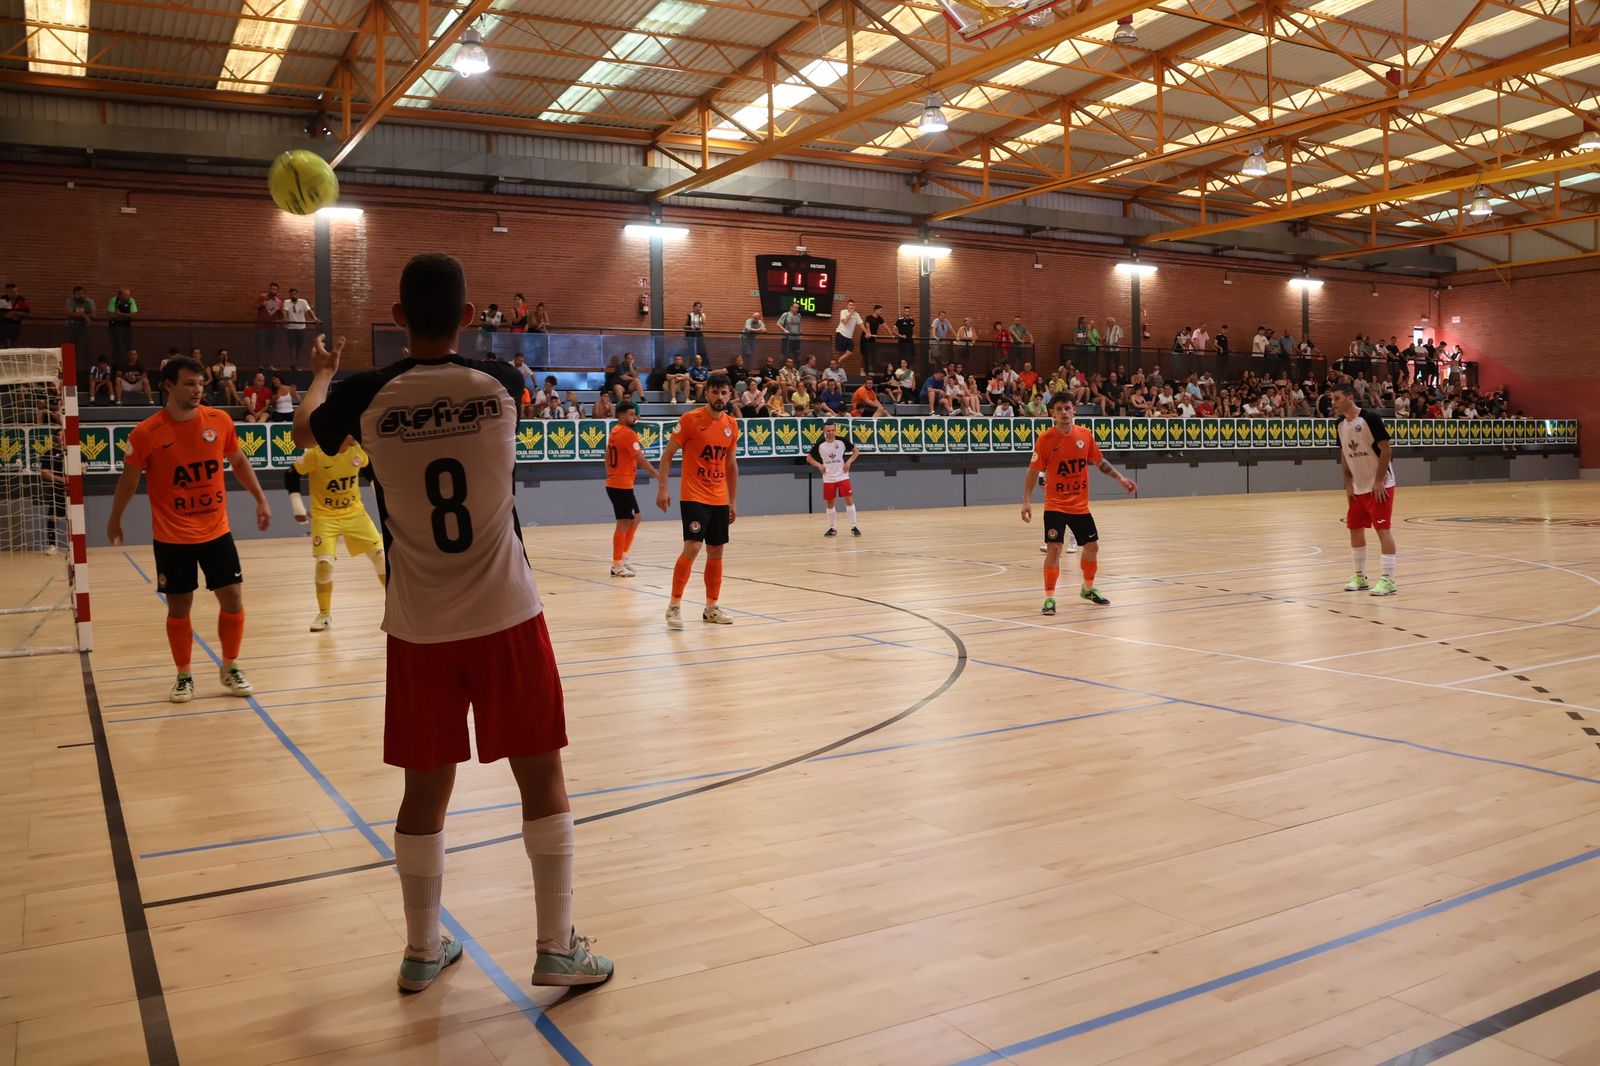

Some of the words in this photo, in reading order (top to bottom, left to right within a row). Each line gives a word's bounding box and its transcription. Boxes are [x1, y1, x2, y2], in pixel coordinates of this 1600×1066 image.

[820, 273, 828, 288] 2
[173, 460, 219, 487] ATP
[1057, 458, 1086, 476] ATP
[174, 490, 223, 510] RIOS
[425, 458, 473, 554] 8
